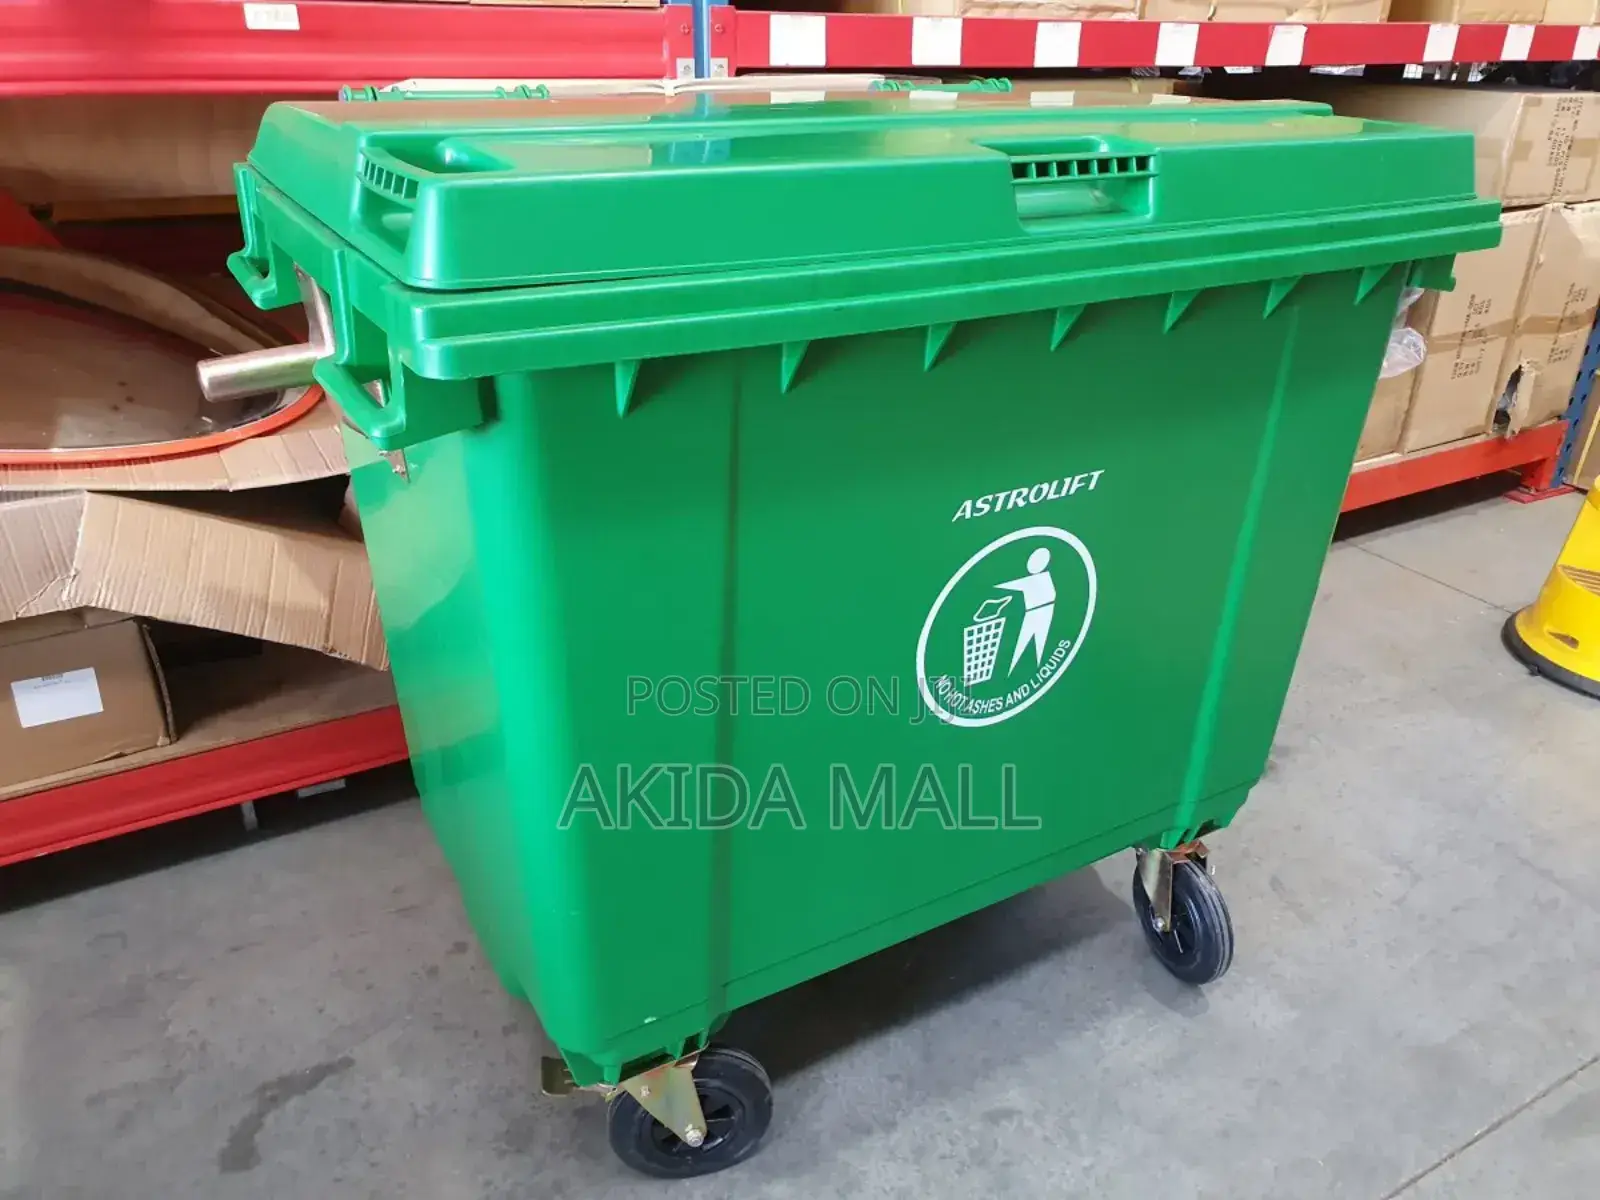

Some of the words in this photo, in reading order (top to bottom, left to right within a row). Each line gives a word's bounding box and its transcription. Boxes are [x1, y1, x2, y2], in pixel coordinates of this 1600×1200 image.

[952, 469, 1105, 522] ASTROLIFT
[944, 688, 969, 710] HOT
[964, 697, 1003, 714] ASHES
[1005, 684, 1030, 707] AND
[1030, 639, 1071, 689] LIQUIDS
